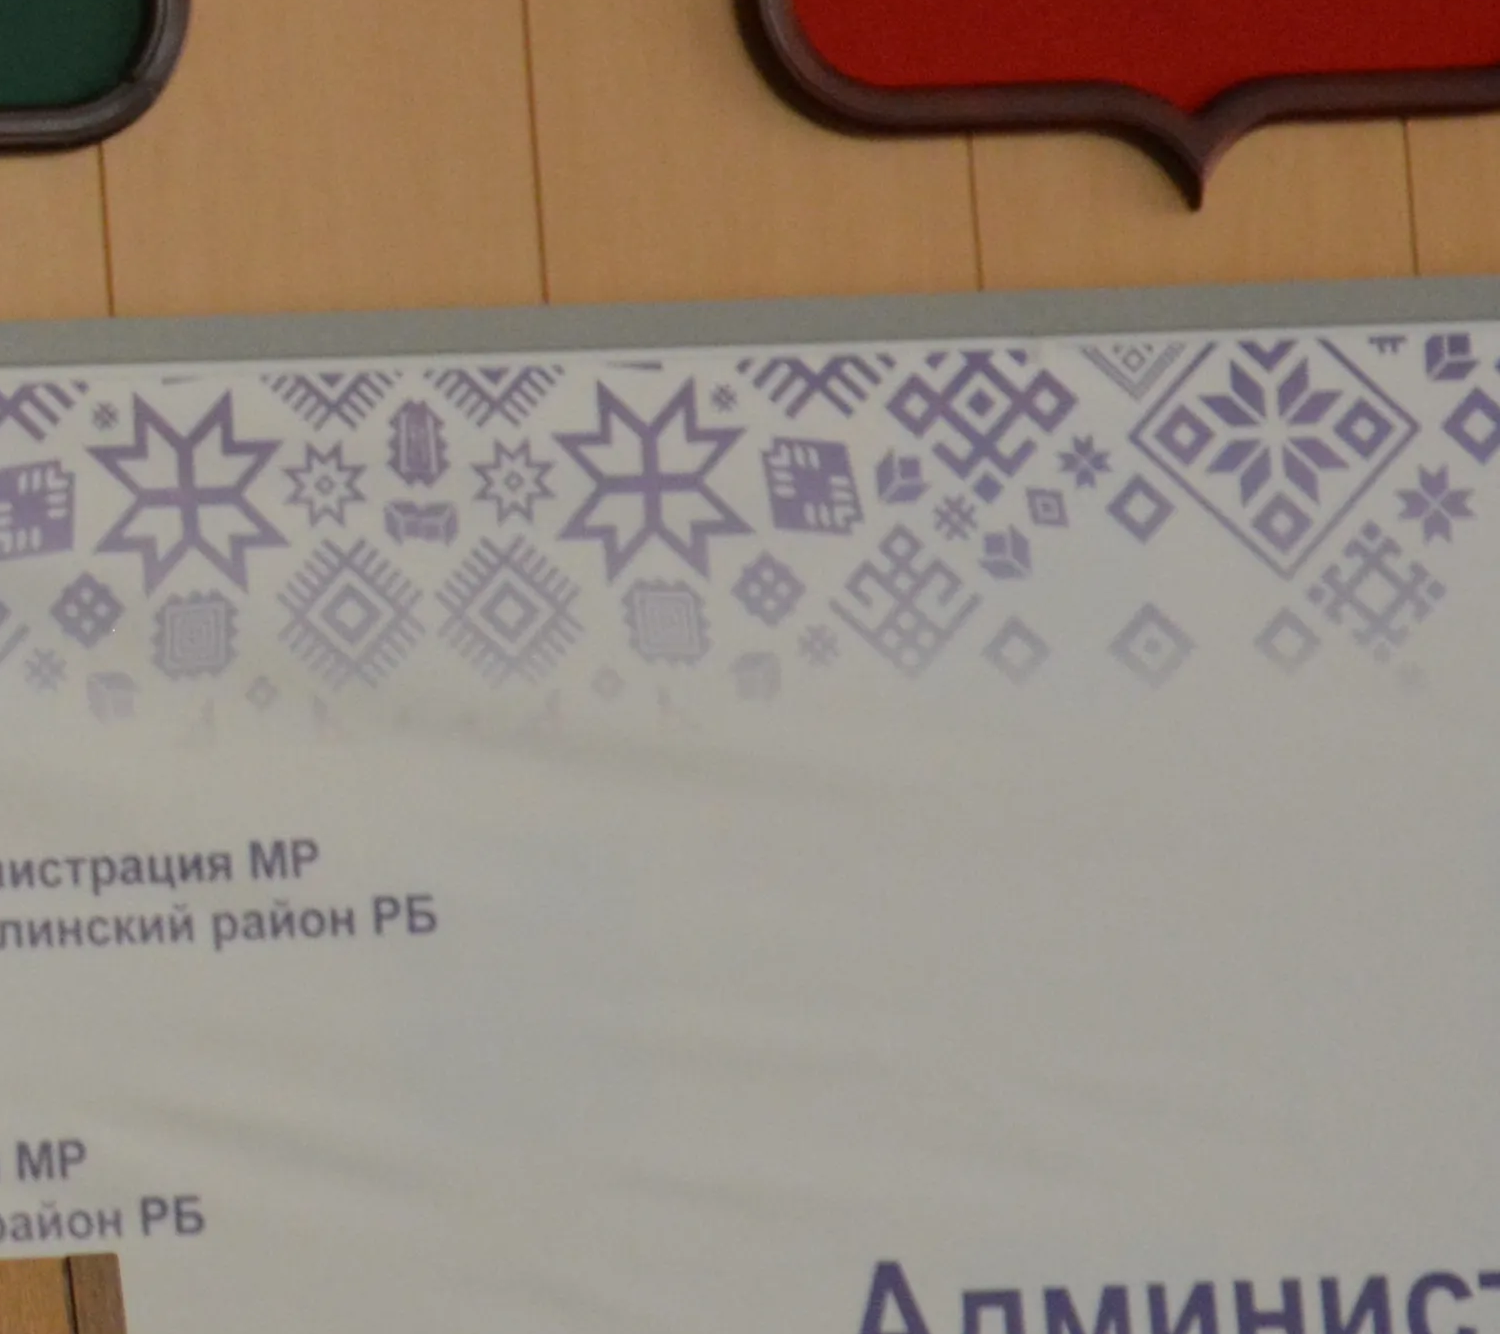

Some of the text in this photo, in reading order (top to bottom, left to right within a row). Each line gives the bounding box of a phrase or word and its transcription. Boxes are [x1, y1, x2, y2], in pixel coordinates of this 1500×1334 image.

[247, 838, 320, 881] МР
[212, 900, 355, 950] район
[373, 894, 437, 936] РБ
[15, 1139, 87, 1181] МР
[140, 1195, 205, 1236] РБ
